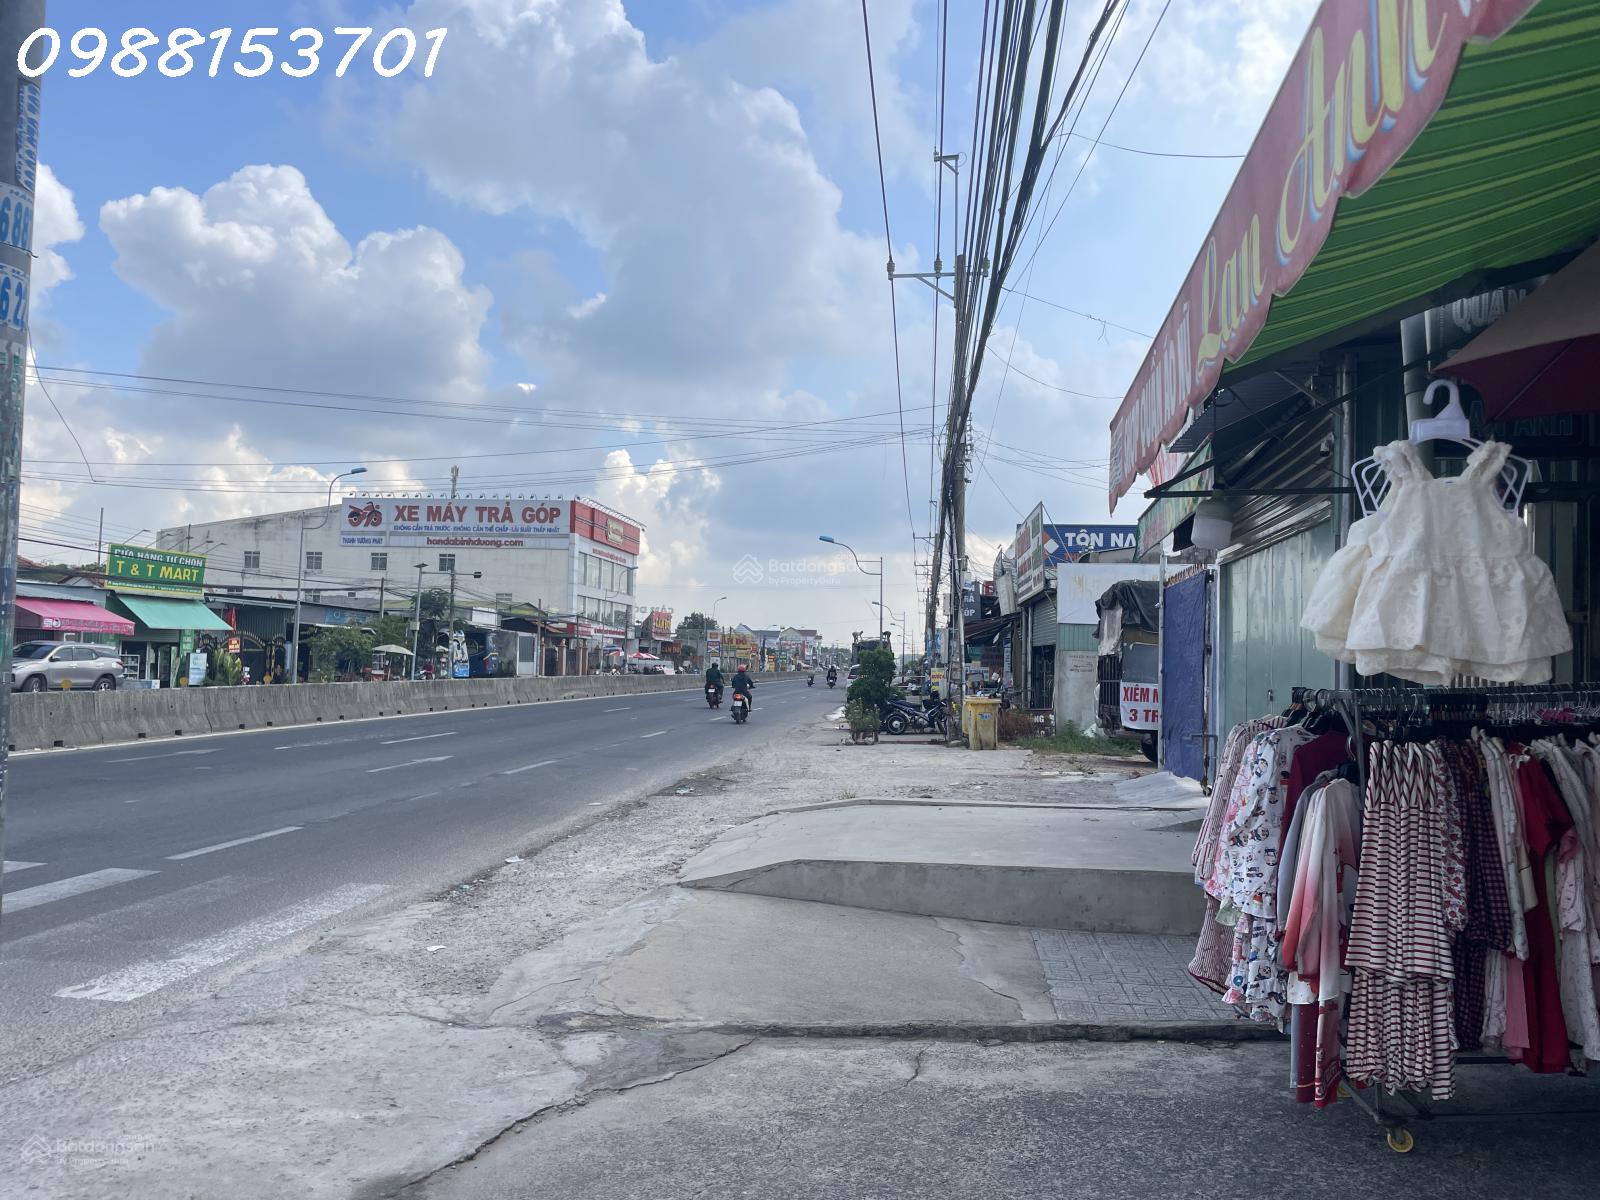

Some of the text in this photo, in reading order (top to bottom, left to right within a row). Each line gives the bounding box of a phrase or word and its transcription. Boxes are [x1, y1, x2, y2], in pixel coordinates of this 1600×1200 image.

[394, 501, 561, 524] XE MÁY TRẢ GÓP
[393, 524, 412, 532] KHÔNG
[453, 525, 472, 533] KHÔNG
[426, 537, 524, 548] hondabinhduong.com
[1064, 528, 1136, 547] TÔN NA
[116, 560, 199, 582] T & T MART
[1129, 708, 1159, 723] 3 TR
